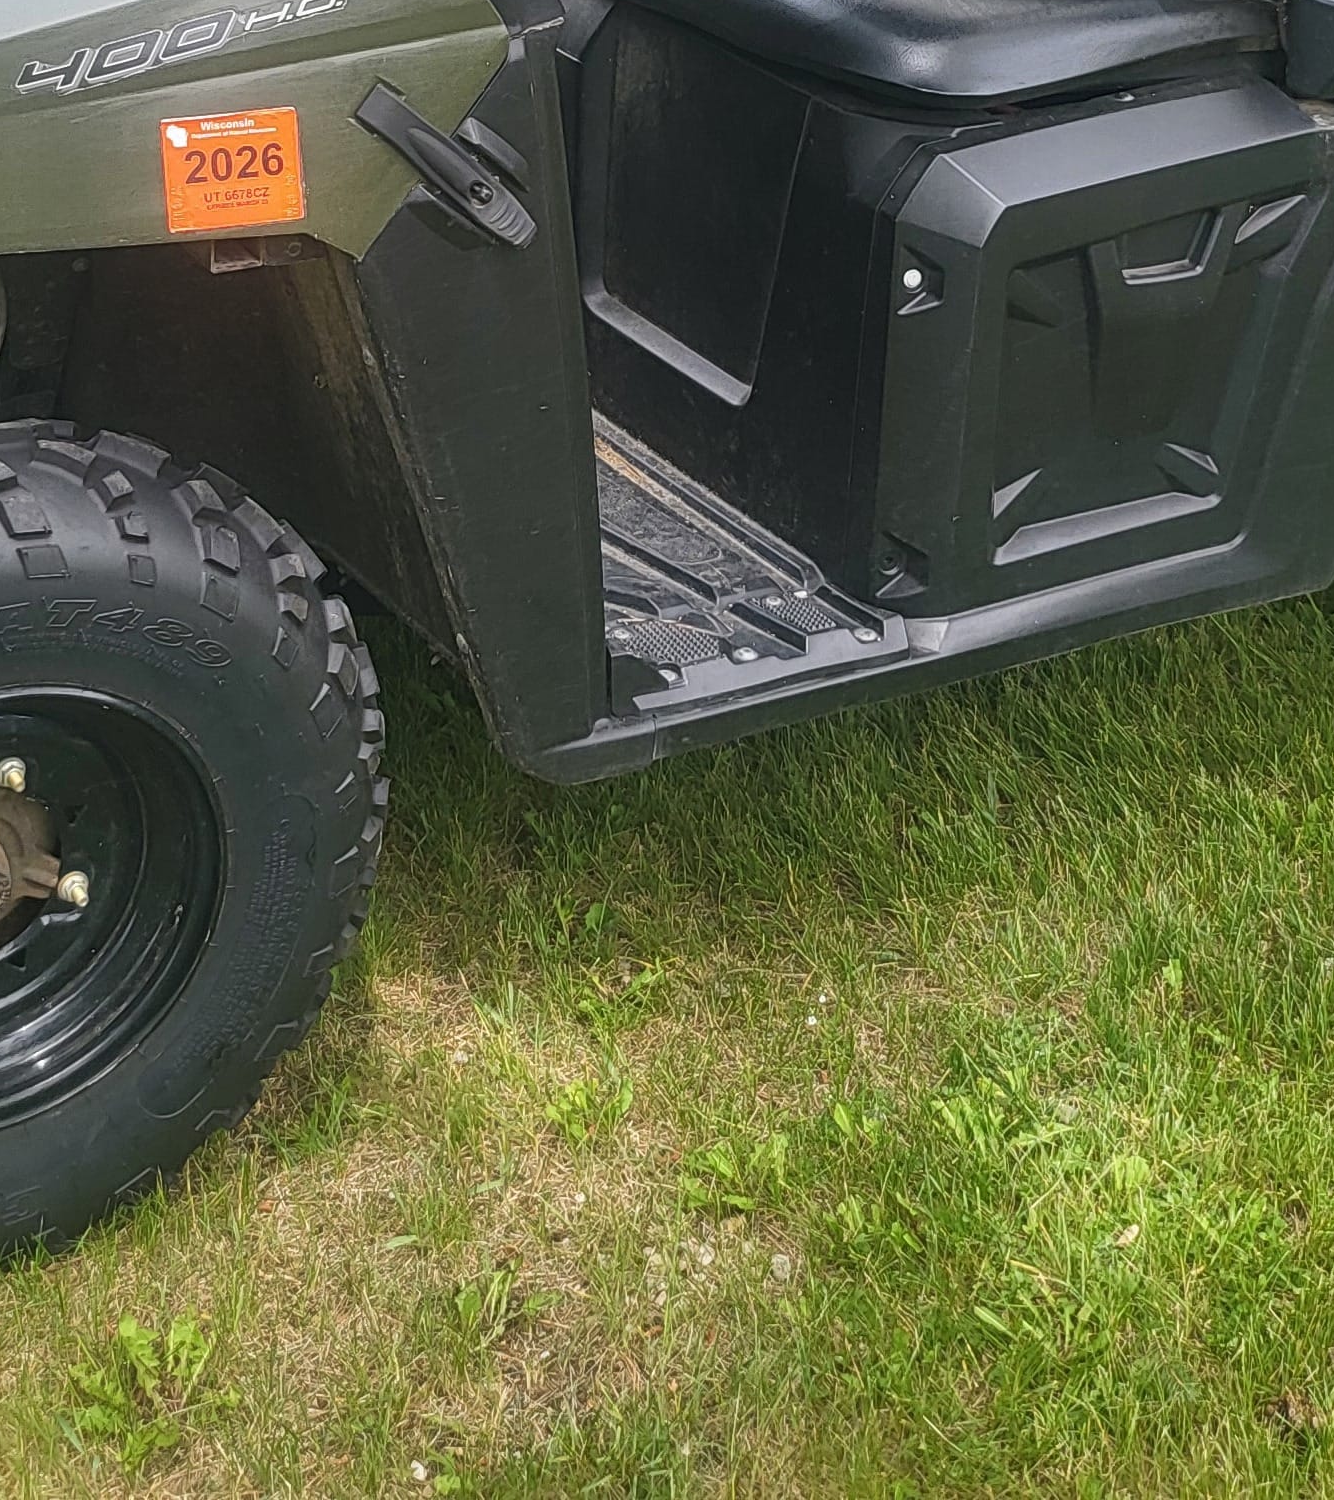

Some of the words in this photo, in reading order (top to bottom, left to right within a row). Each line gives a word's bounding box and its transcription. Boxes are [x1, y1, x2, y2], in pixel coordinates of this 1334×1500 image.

[13, 9, 243, 95] 400
[200, 117, 255, 131] Wisconsin
[184, 142, 284, 185] 2026
[203, 191, 220, 203] UT
